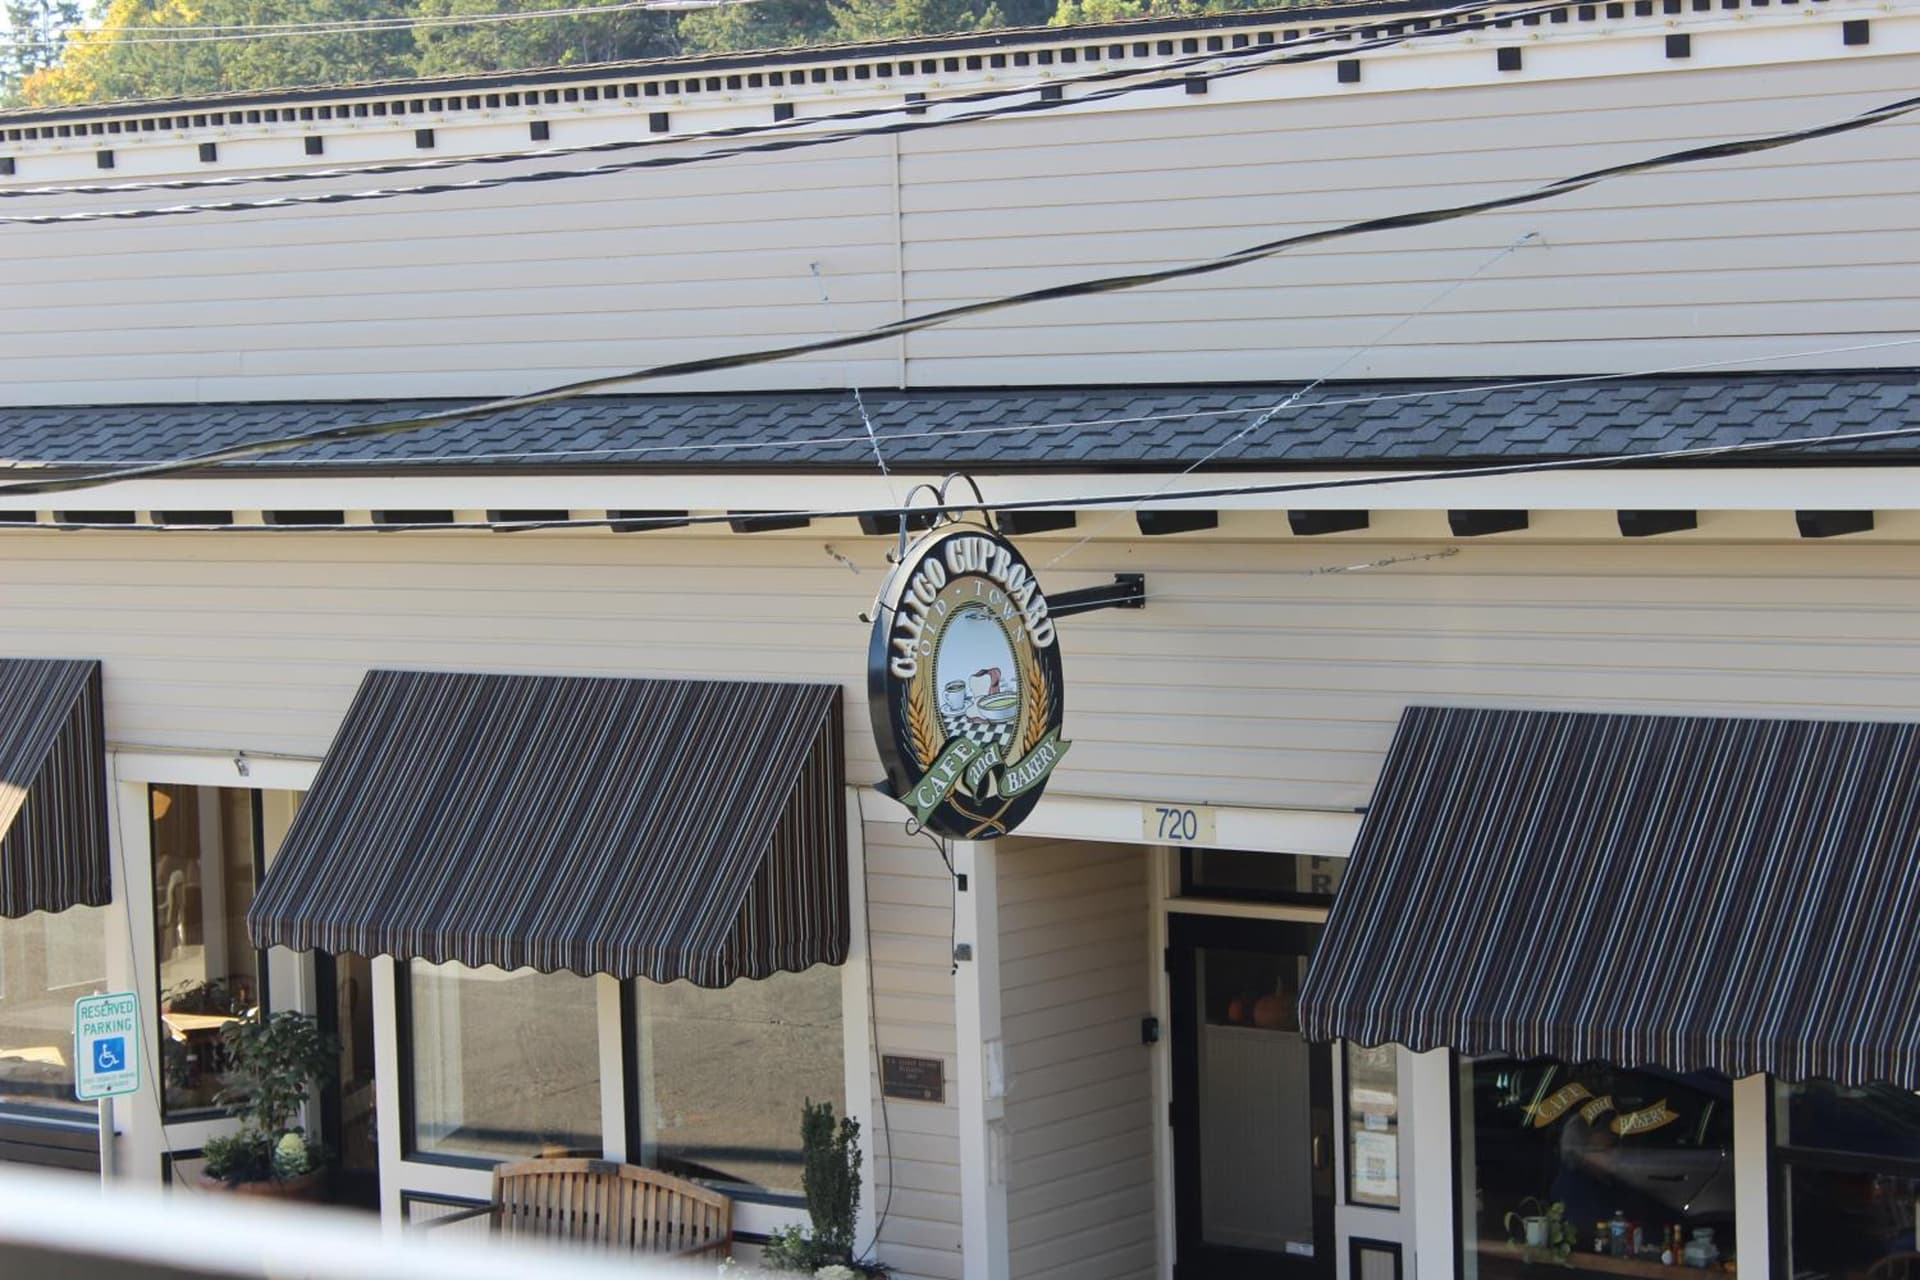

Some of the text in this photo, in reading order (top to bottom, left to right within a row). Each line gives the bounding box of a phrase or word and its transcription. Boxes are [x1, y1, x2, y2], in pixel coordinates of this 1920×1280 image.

[891, 537, 1056, 678] CALICO CUPBOARD
[920, 580, 1025, 656] OLD TOWN
[917, 736, 1057, 808] CAFE and BAKERY
[1156, 808, 1197, 840] 720
[81, 1001, 133, 1018] RESERVED
[84, 1018, 132, 1035] PARKING
[1619, 1106, 1667, 1131] BAKERY
